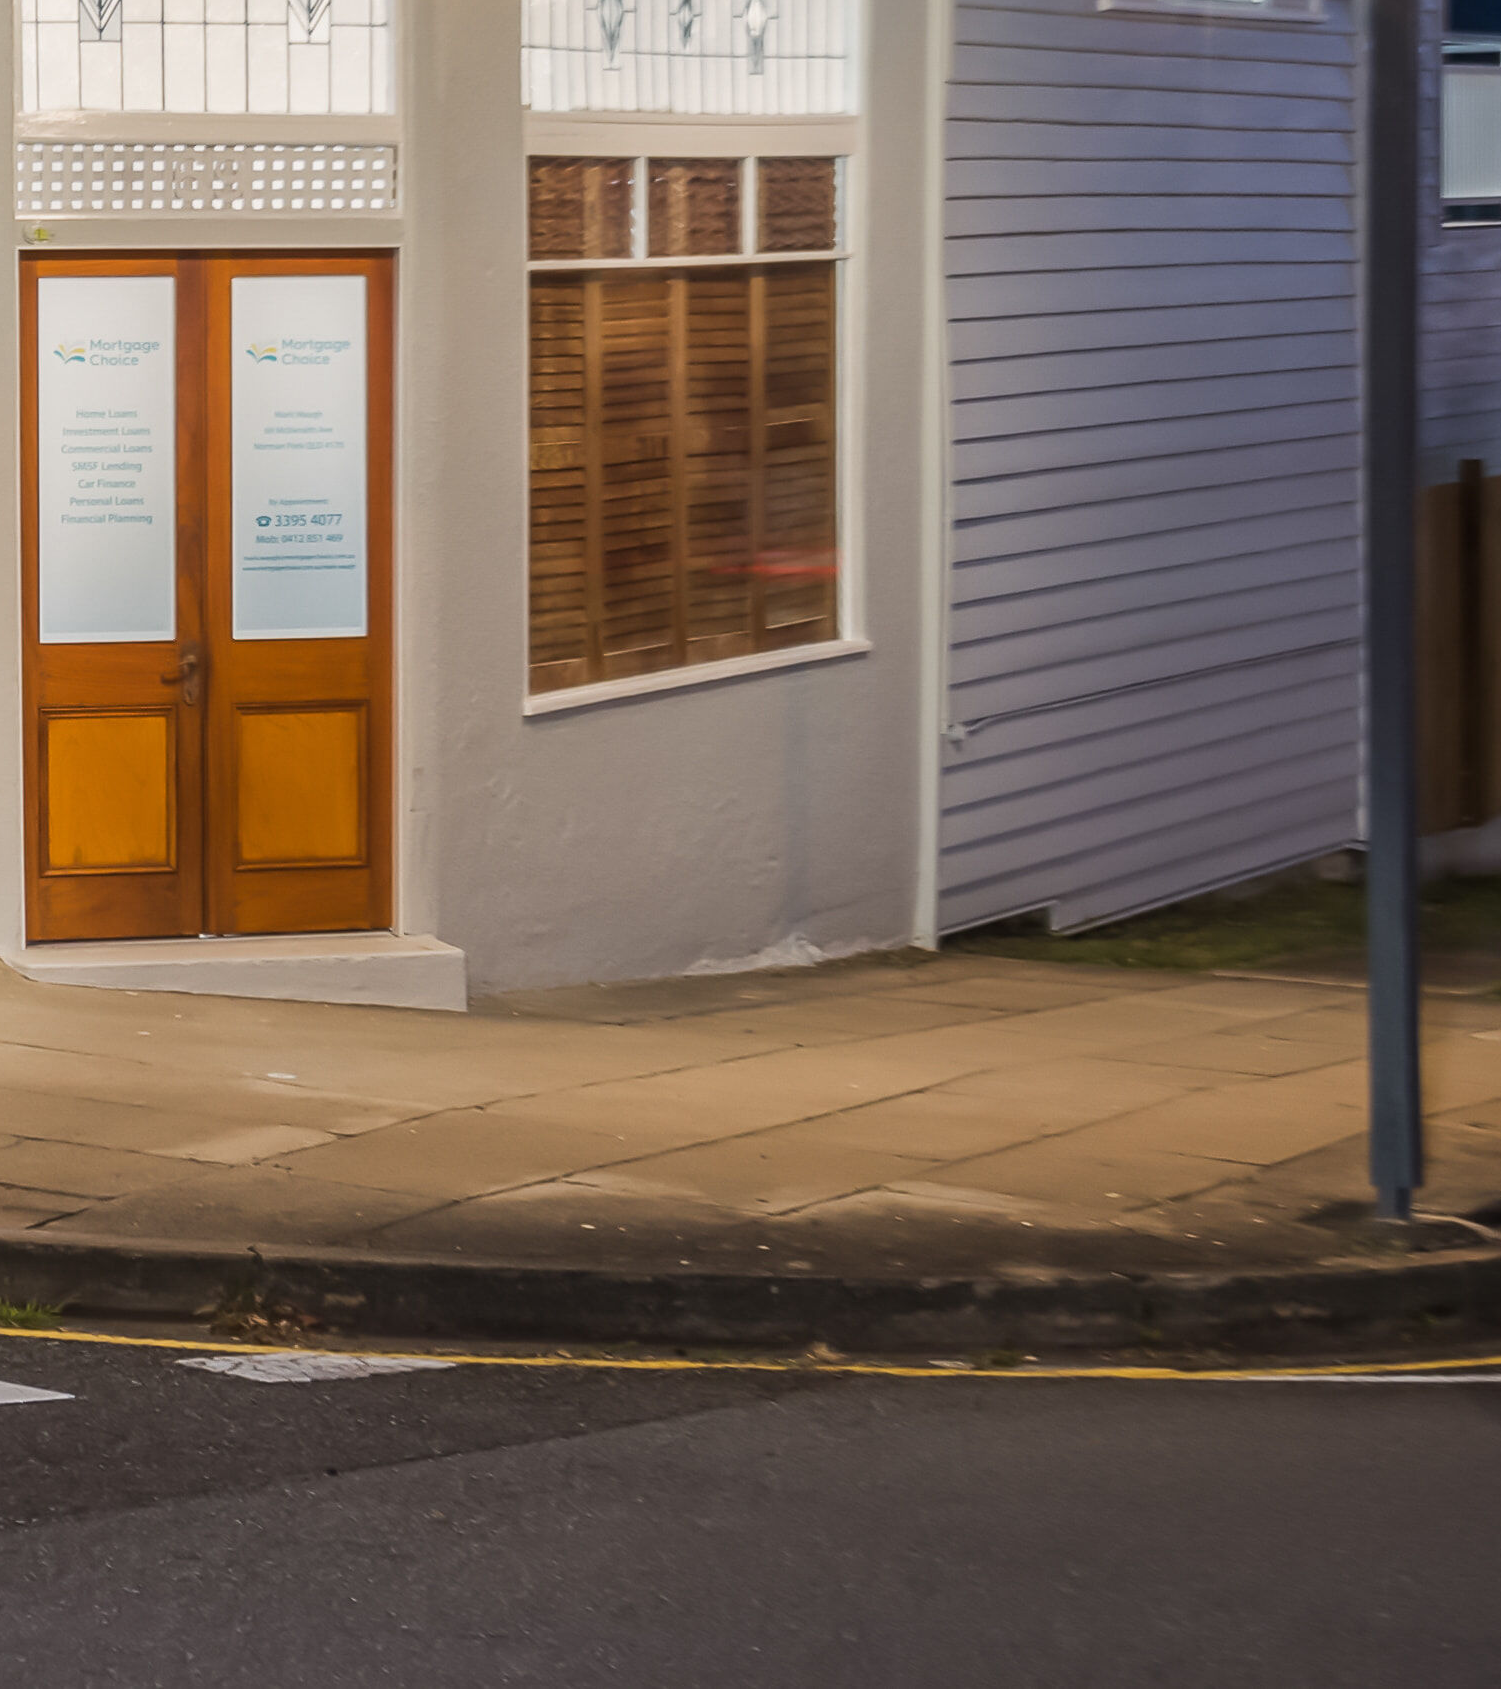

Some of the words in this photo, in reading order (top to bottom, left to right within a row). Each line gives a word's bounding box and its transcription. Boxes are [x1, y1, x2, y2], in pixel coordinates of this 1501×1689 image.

[90, 339, 160, 353] Mortgage
[282, 339, 351, 353] Mortgage
[90, 354, 139, 366] Choice
[282, 353, 330, 365] Choice
[76, 410, 106, 419] Home
[108, 410, 138, 419] Loans
[62, 428, 119, 436] Investment
[121, 428, 151, 436] Loans
[61, 444, 121, 454] Commercial
[123, 444, 153, 453] Loans
[101, 462, 143, 473] Lending
[77, 479, 95, 488] Car
[97, 479, 136, 488] Finance
[69, 496, 112, 506] Personal
[115, 496, 145, 506] Loans
[61, 514, 106, 524] Financial
[108, 513, 153, 525] Planning
[274, 513, 307, 526] 3395
[310, 513, 343, 526] 4077
